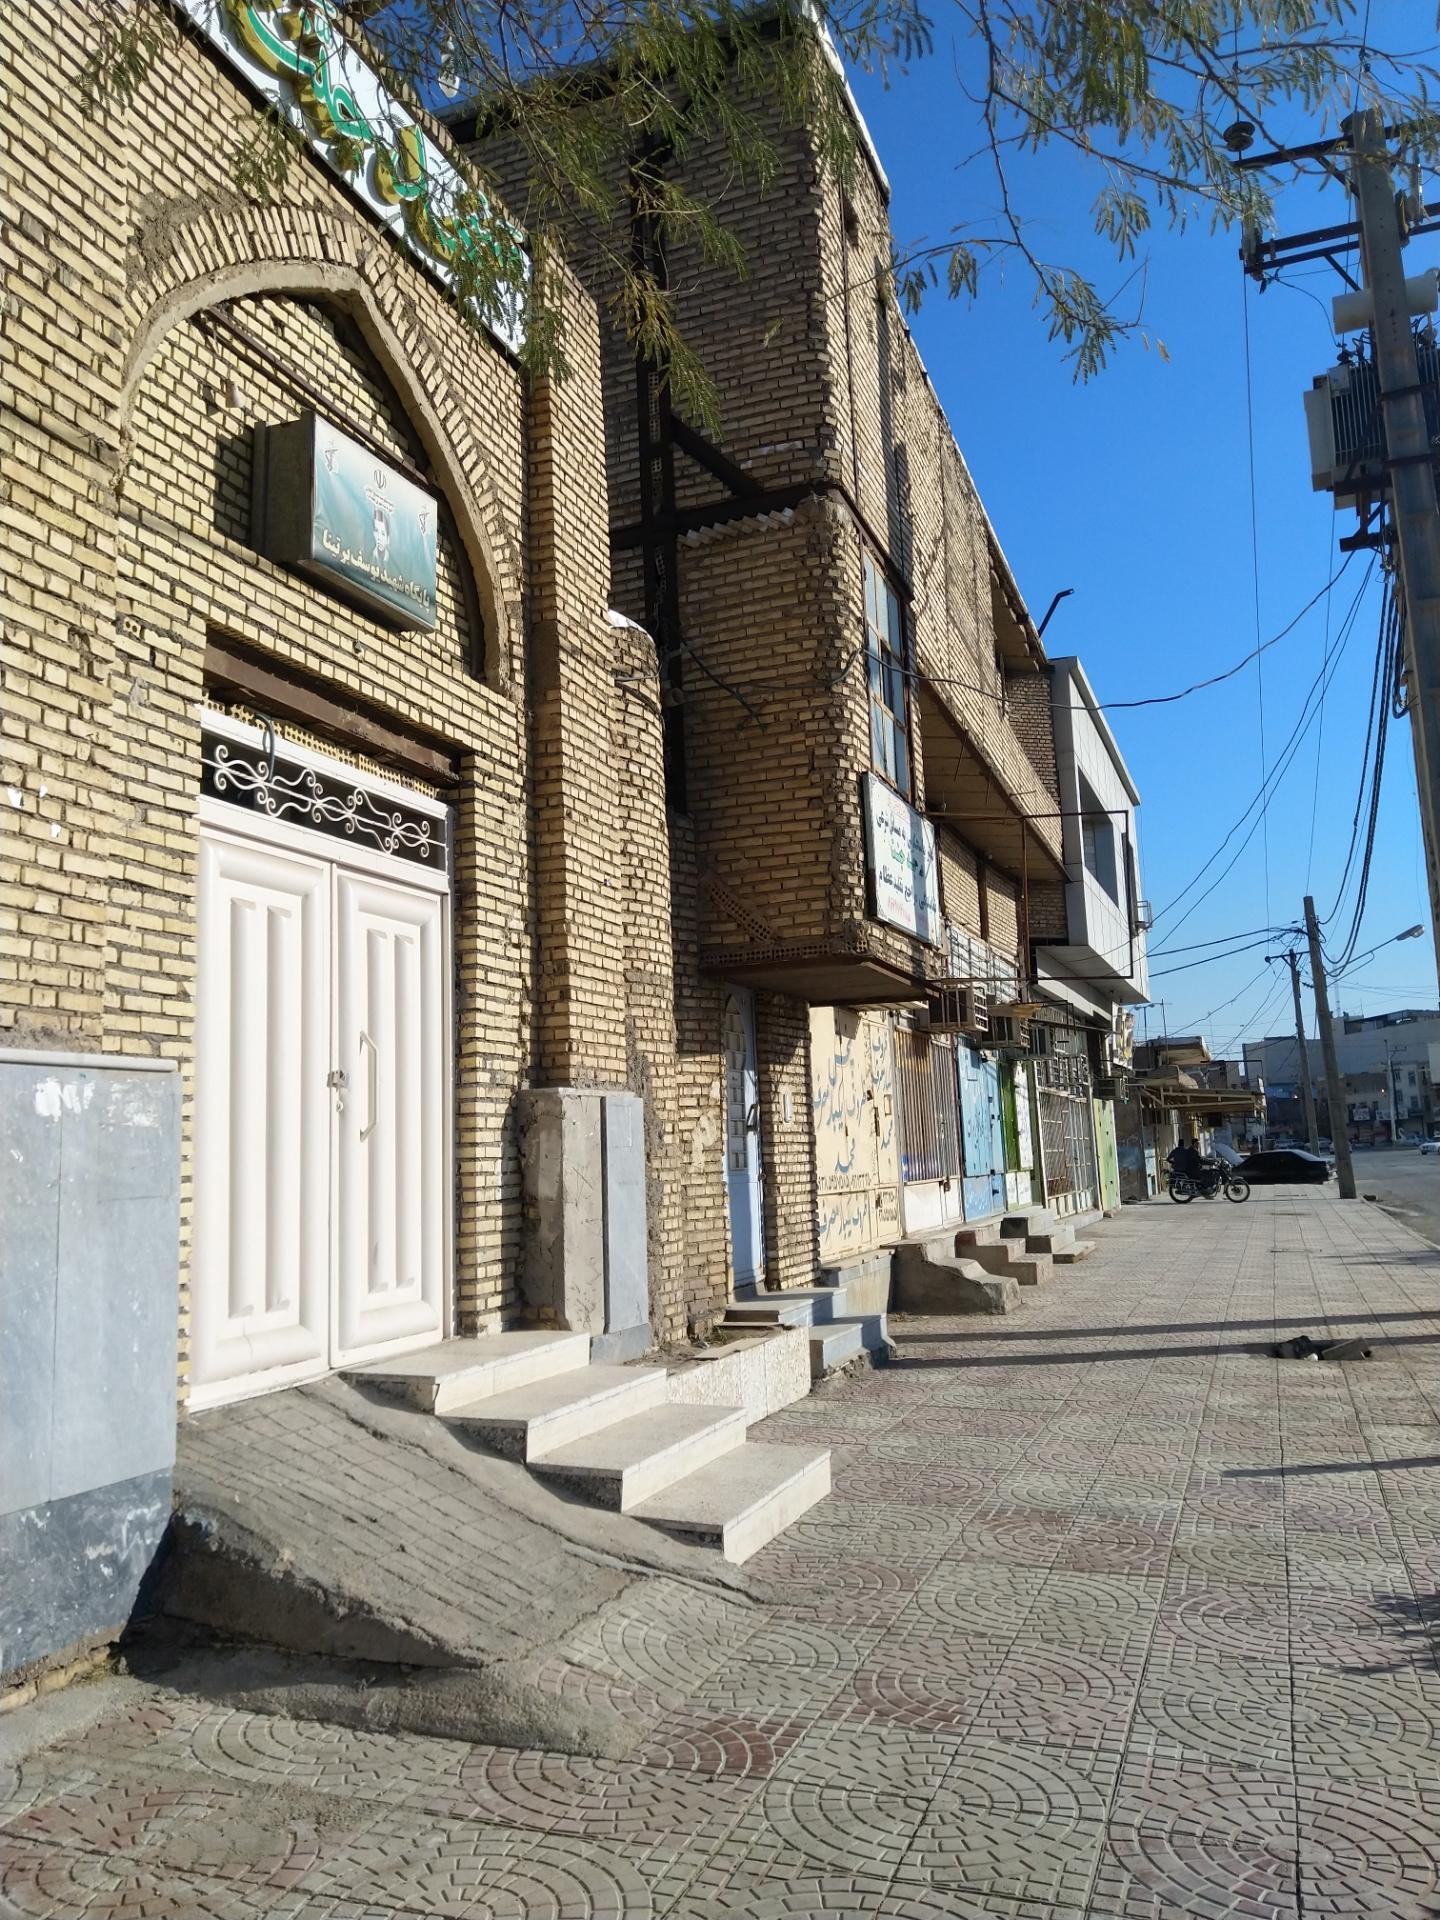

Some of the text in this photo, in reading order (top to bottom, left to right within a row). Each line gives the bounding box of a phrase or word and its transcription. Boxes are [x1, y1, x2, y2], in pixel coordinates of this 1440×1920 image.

[350, 550, 380, 583] یوسف
[380, 569, 403, 593] شهید
[404, 581, 430, 614] پایگاه
[835, 1137, 855, 1174] محمد
